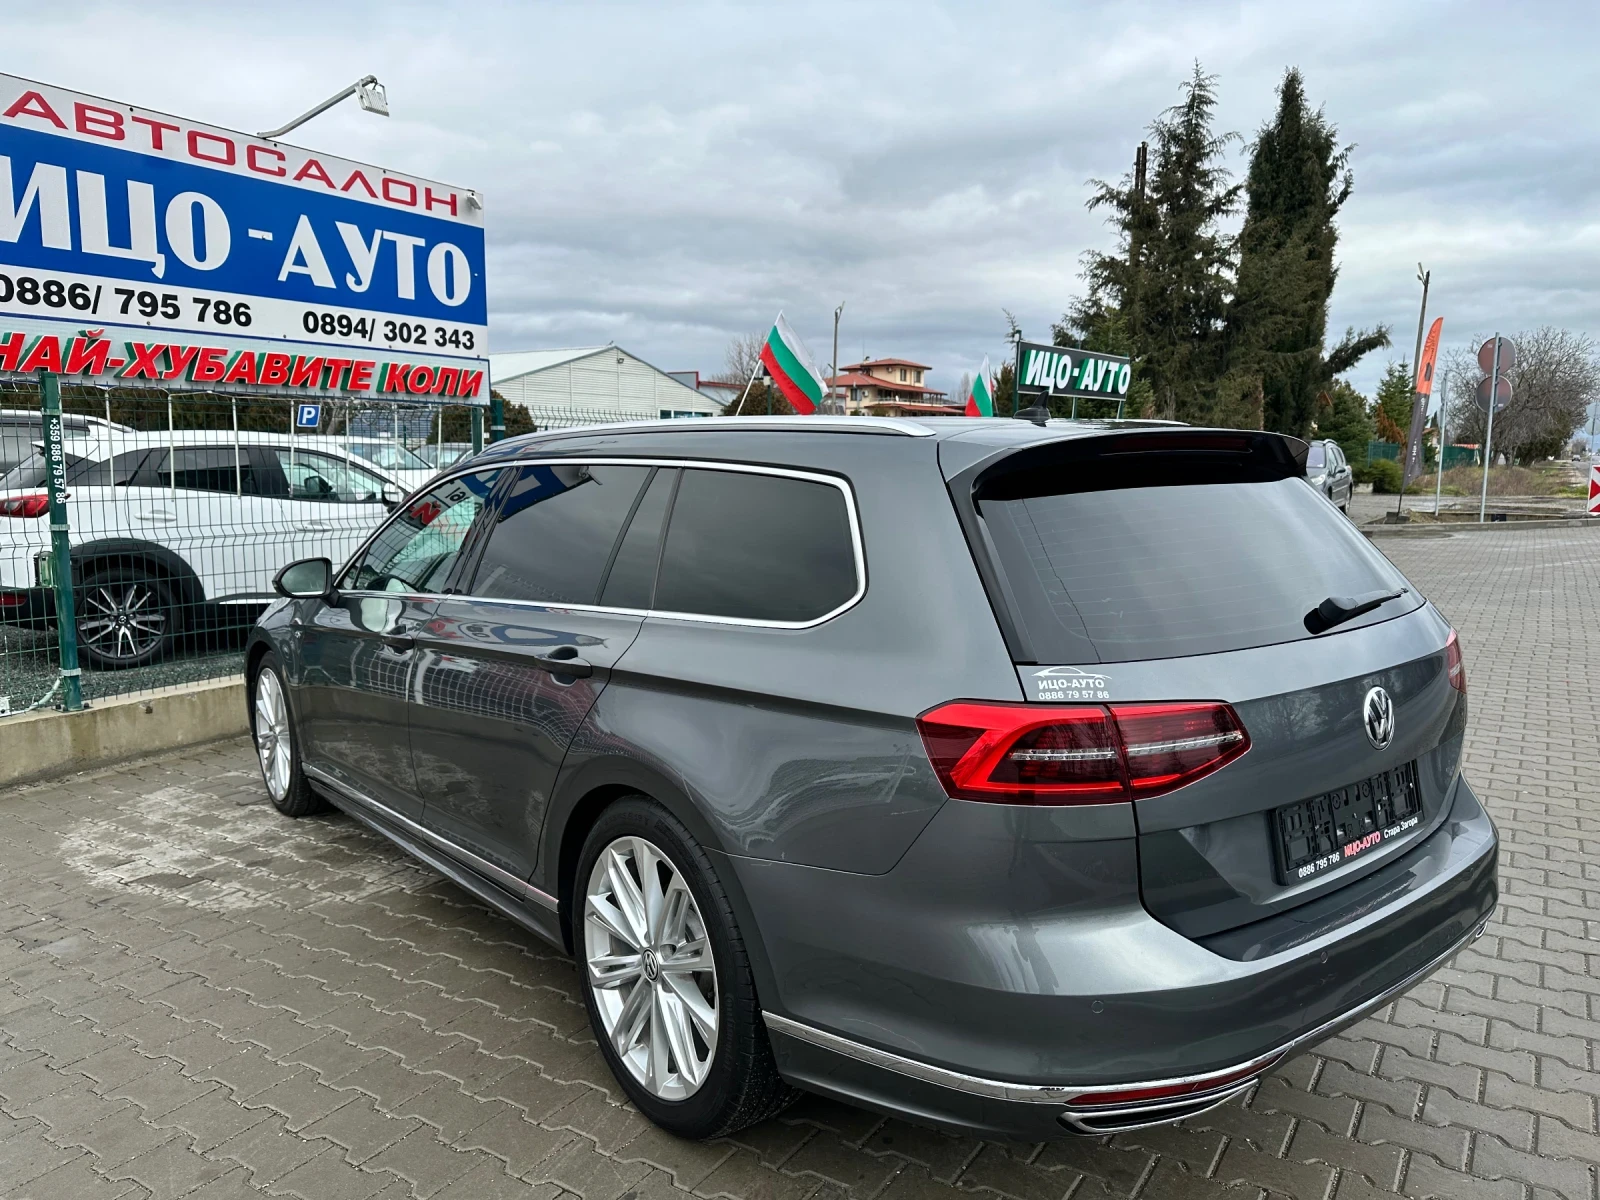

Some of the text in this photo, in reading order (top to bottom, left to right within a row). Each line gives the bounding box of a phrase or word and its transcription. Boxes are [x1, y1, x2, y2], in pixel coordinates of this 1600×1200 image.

[3, 90, 458, 217] АВТОСАЛОН
[114, 287, 181, 320] 795
[192, 297, 252, 327] 786
[383, 320, 427, 345] 302
[434, 327, 475, 350] 343
[377, 362, 484, 397] КОЛИ
[1022, 349, 1131, 395] ИЦО-АУТО
[302, 407, 315, 424] P
[49, 418, 66, 504] +359 886 79 57 86
[1038, 679, 1105, 690] ИЦО-АУТО
[1038, 691, 1109, 700] 0886 79 57 86
[1298, 816, 1418, 878] 0886 795 786 ИЦО-АУТО Стара Загора
